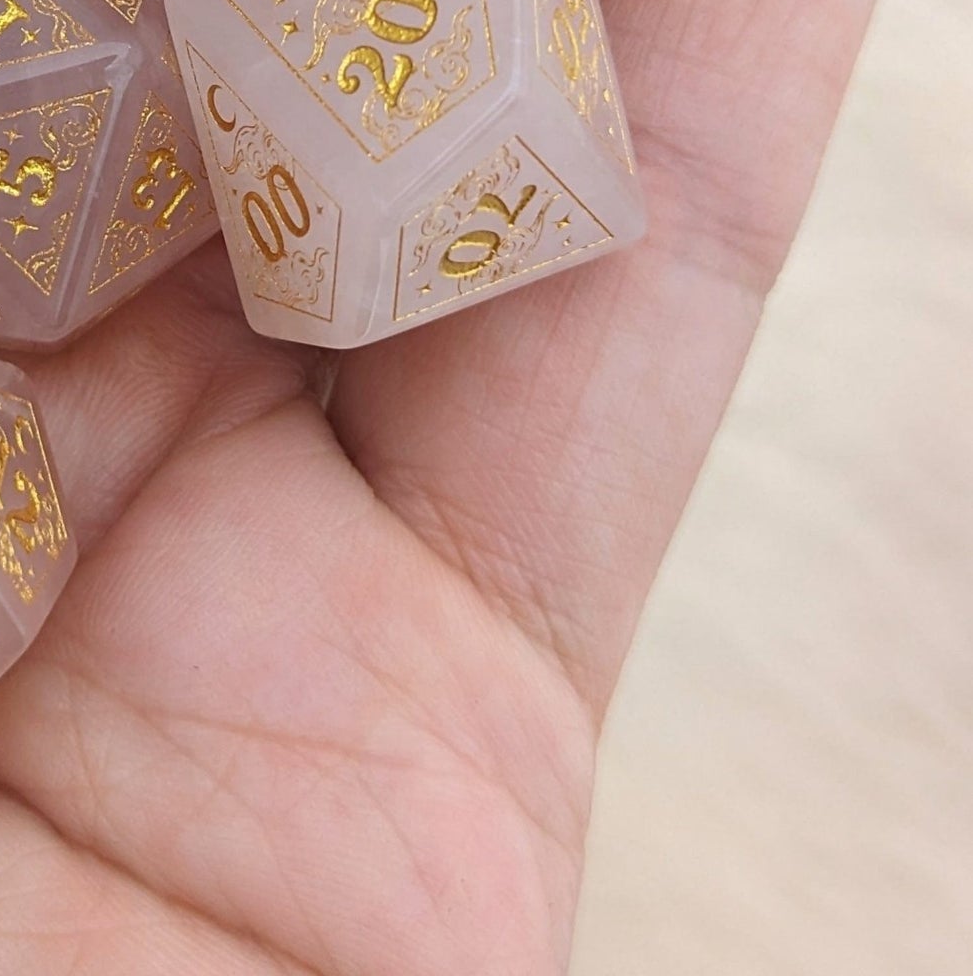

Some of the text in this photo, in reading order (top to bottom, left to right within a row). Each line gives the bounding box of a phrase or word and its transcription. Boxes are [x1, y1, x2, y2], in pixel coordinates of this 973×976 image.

[130, 146, 198, 231] 13
[240, 163, 312, 264] 00
[437, 183, 538, 279] 70
